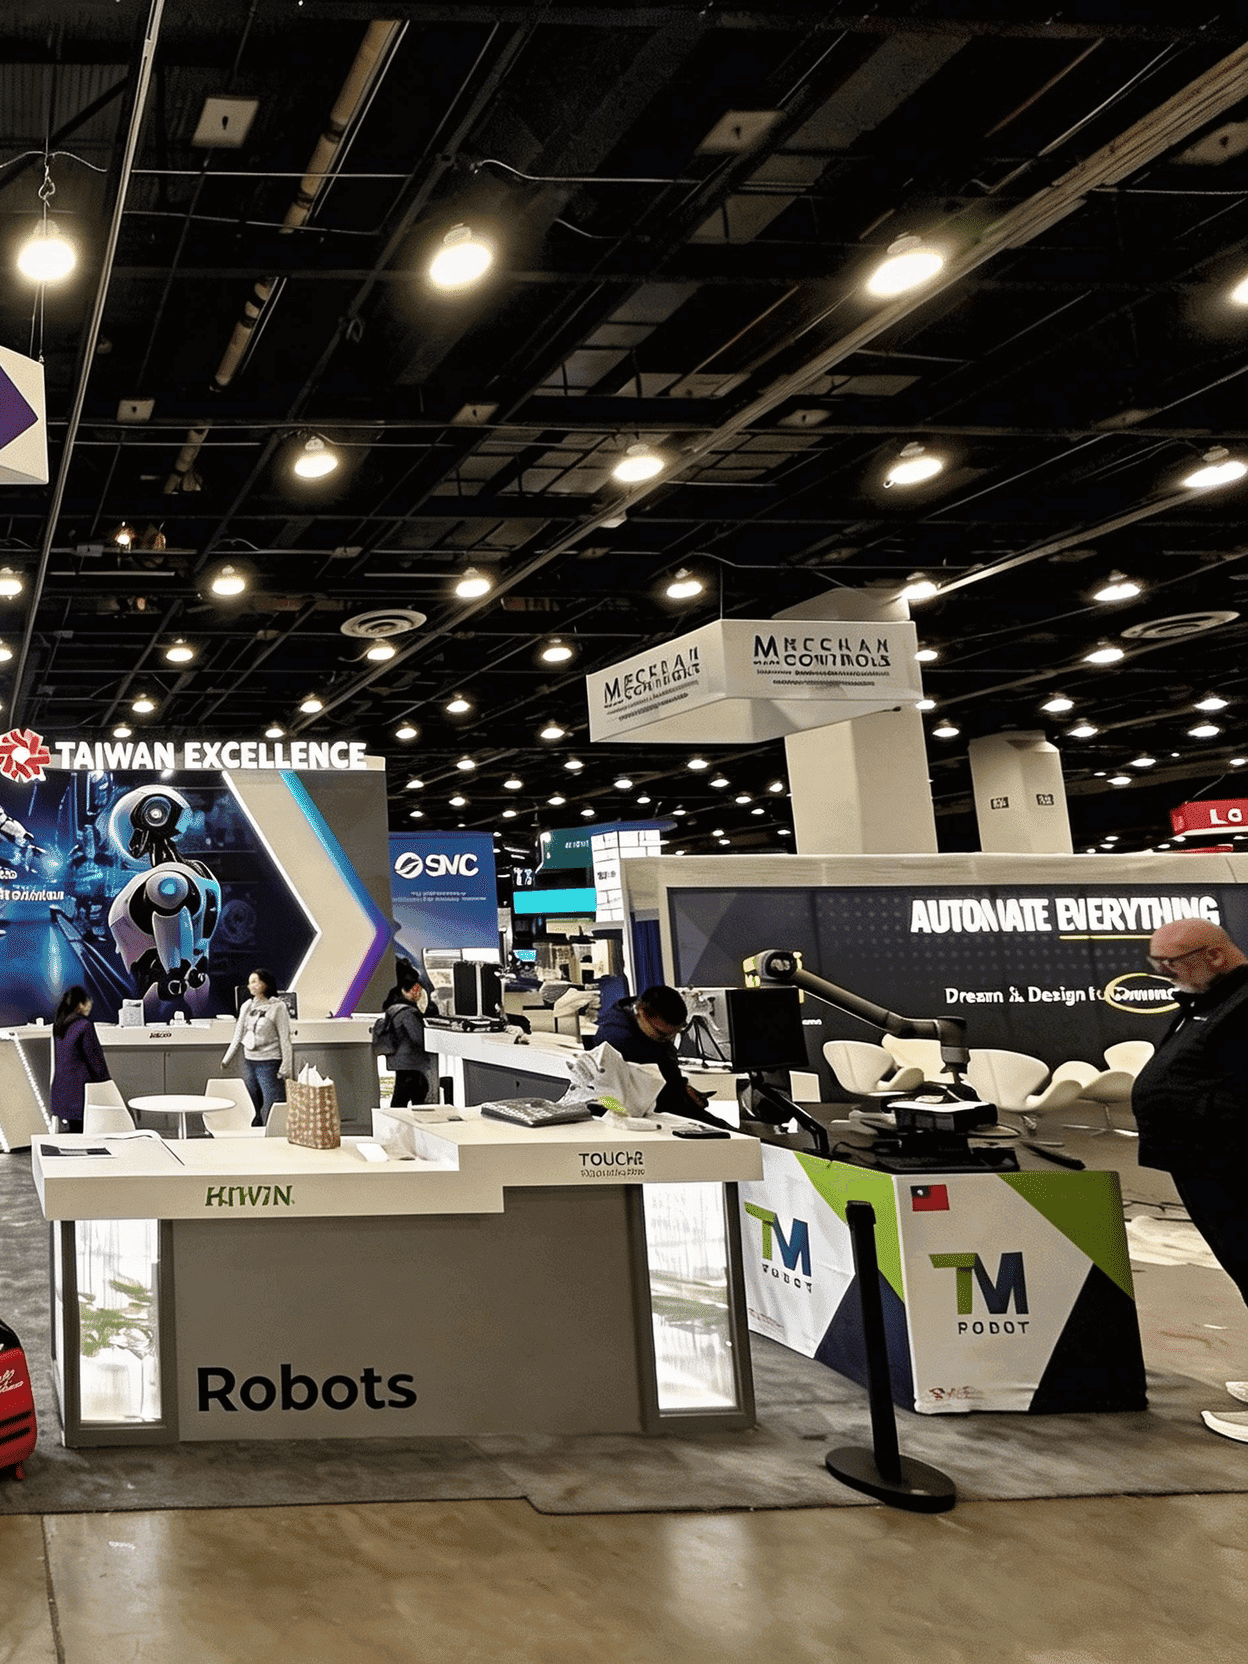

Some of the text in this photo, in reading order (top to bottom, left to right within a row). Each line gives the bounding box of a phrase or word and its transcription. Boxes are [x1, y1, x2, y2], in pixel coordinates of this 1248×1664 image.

[55, 741, 368, 770] TAIWAN EXCELLENCE
[910, 896, 1222, 934] AUTOMATE EVERYTHING
[1028, 986, 1084, 1007] Design
[744, 1201, 812, 1278] TM
[928, 1251, 1030, 1316] TM
[197, 1363, 418, 1412] Robots
